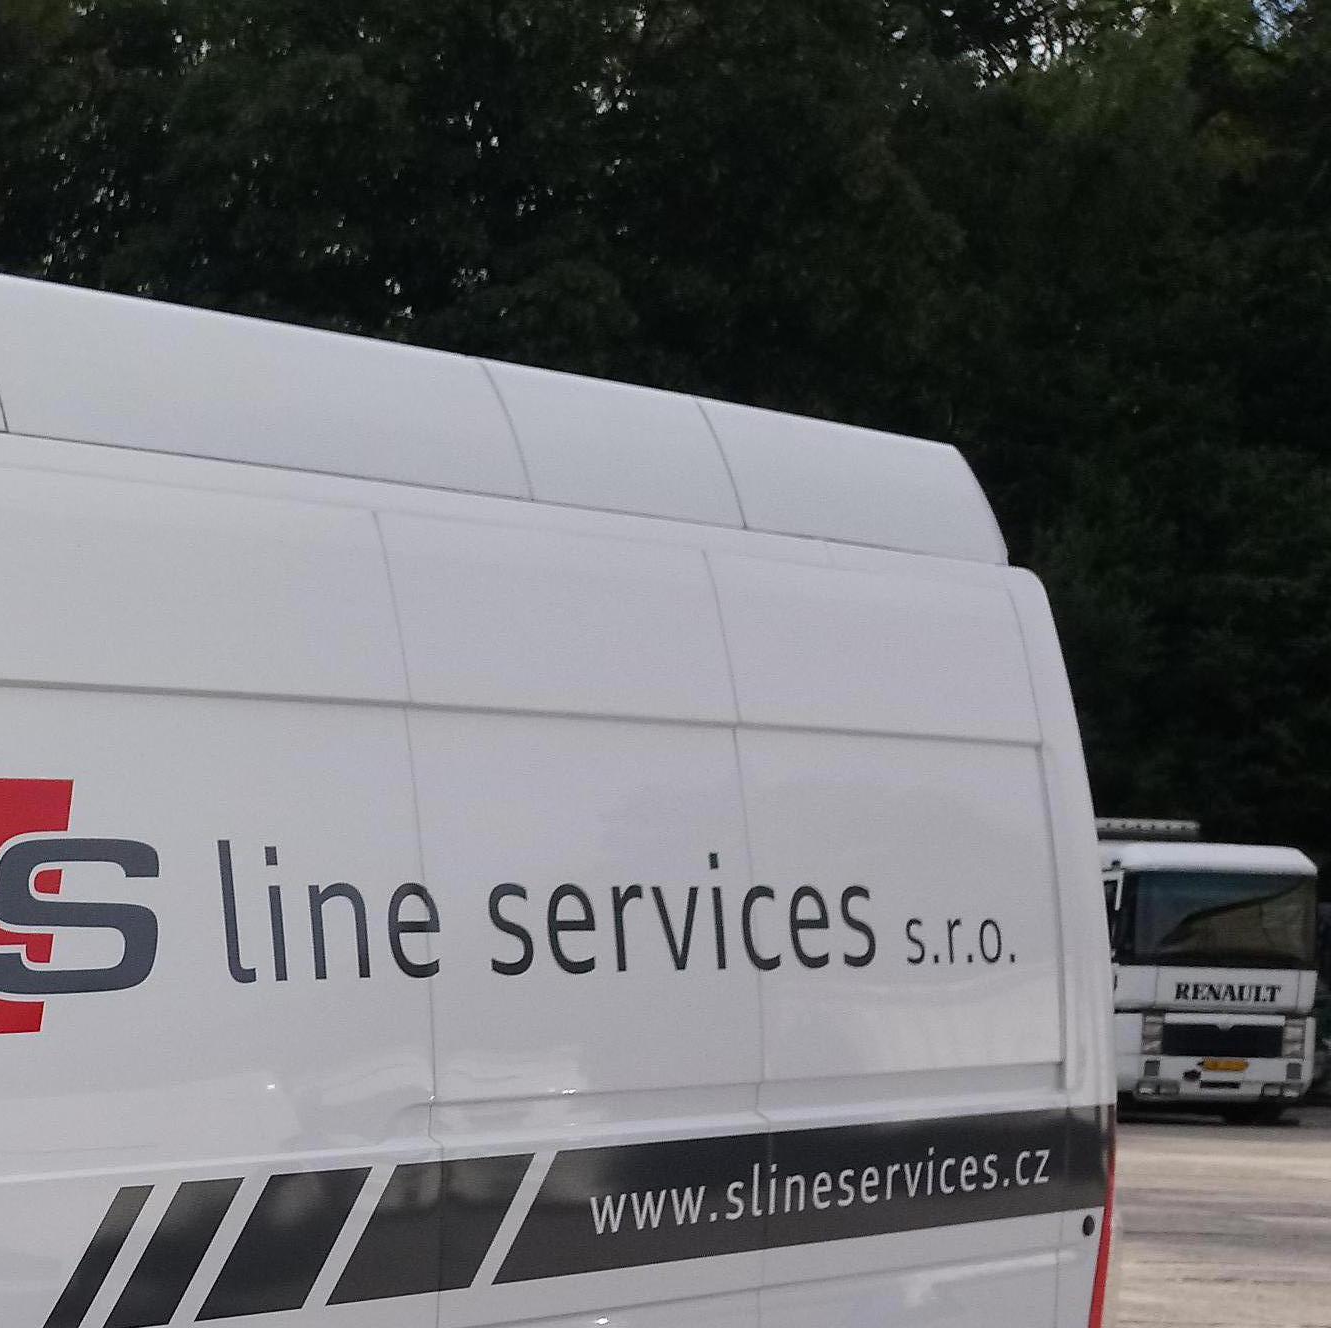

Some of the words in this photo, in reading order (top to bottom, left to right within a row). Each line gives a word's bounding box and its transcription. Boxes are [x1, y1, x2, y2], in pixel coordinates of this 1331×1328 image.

[217, 838, 442, 984] line
[487, 850, 878, 977] services
[905, 916, 1017, 967] s.r.o.
[1174, 982, 1282, 1003] RENAULT
[590, 1146, 1051, 1235] www.slineservices.cz
